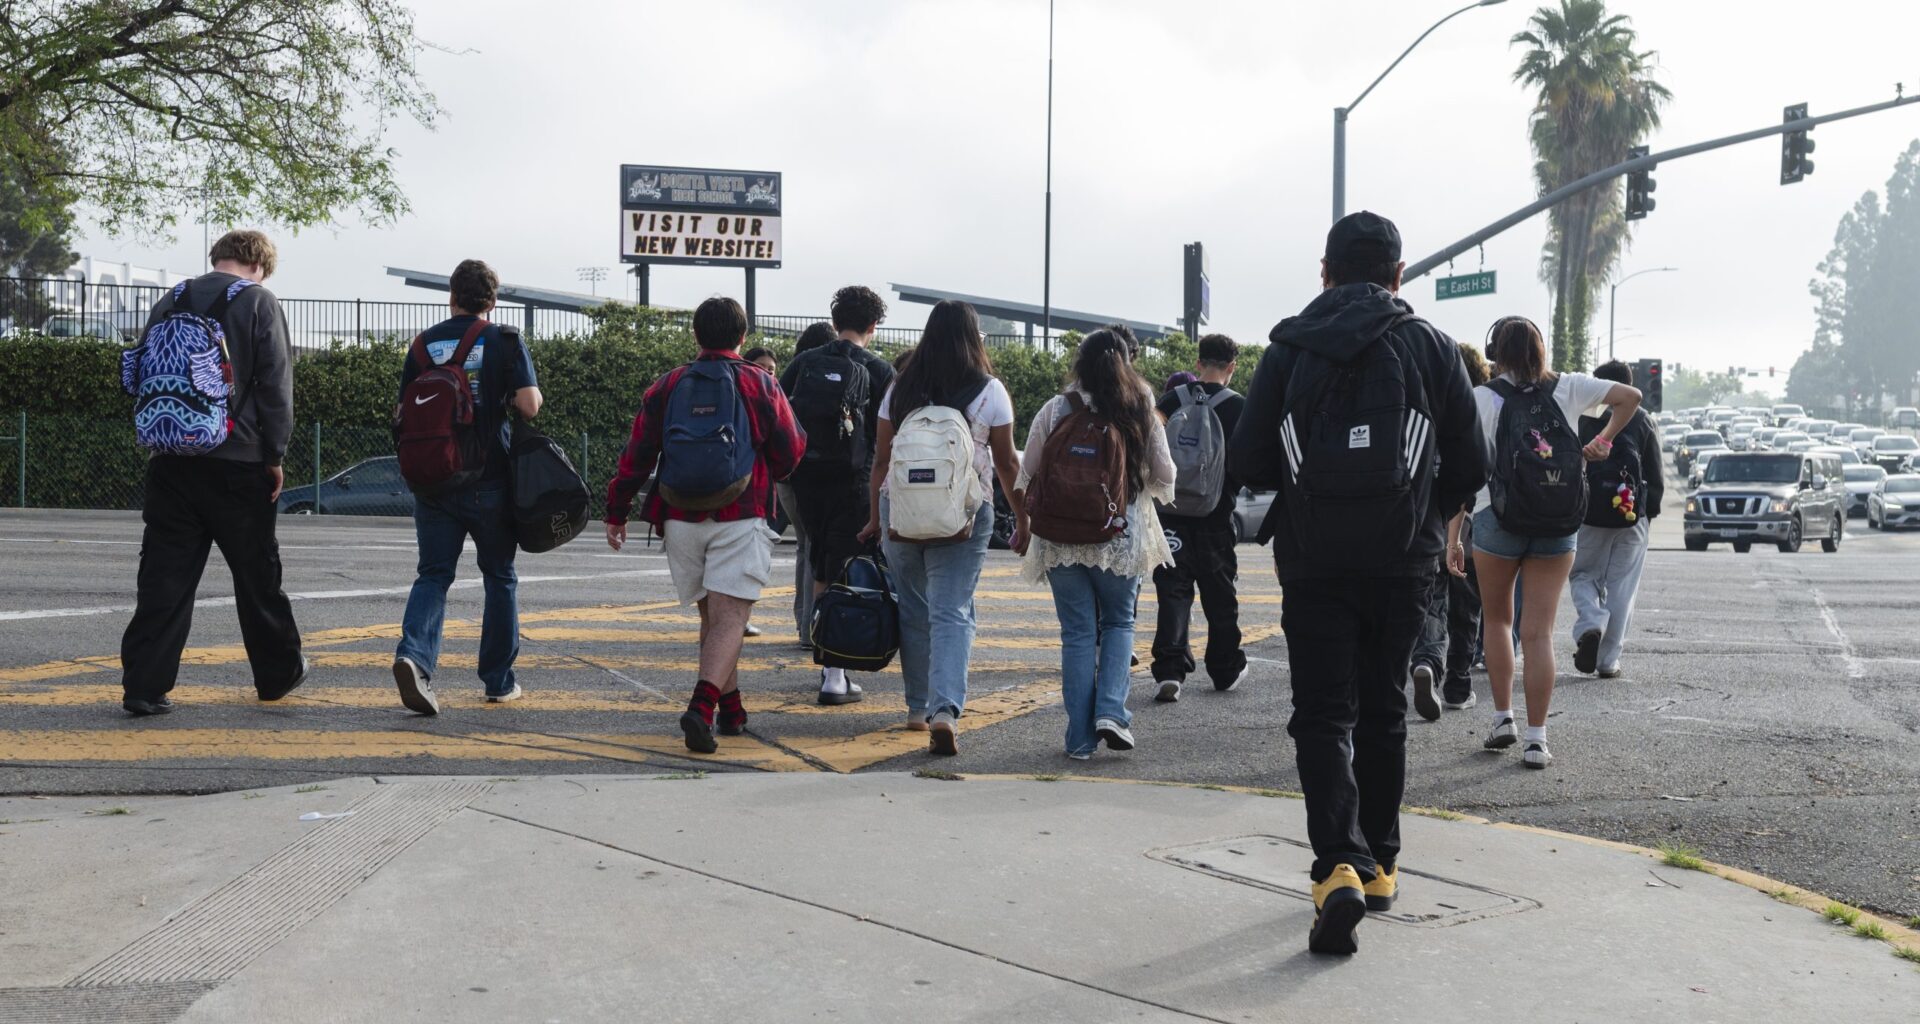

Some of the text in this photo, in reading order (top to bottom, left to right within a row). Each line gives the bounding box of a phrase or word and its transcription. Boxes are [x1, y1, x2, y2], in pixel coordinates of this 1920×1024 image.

[709, 175, 746, 192] VISTA
[632, 213, 763, 236] VISIT OUR
[634, 236, 774, 258] NEW WEBSITE!
[1450, 276, 1492, 293] East H St
